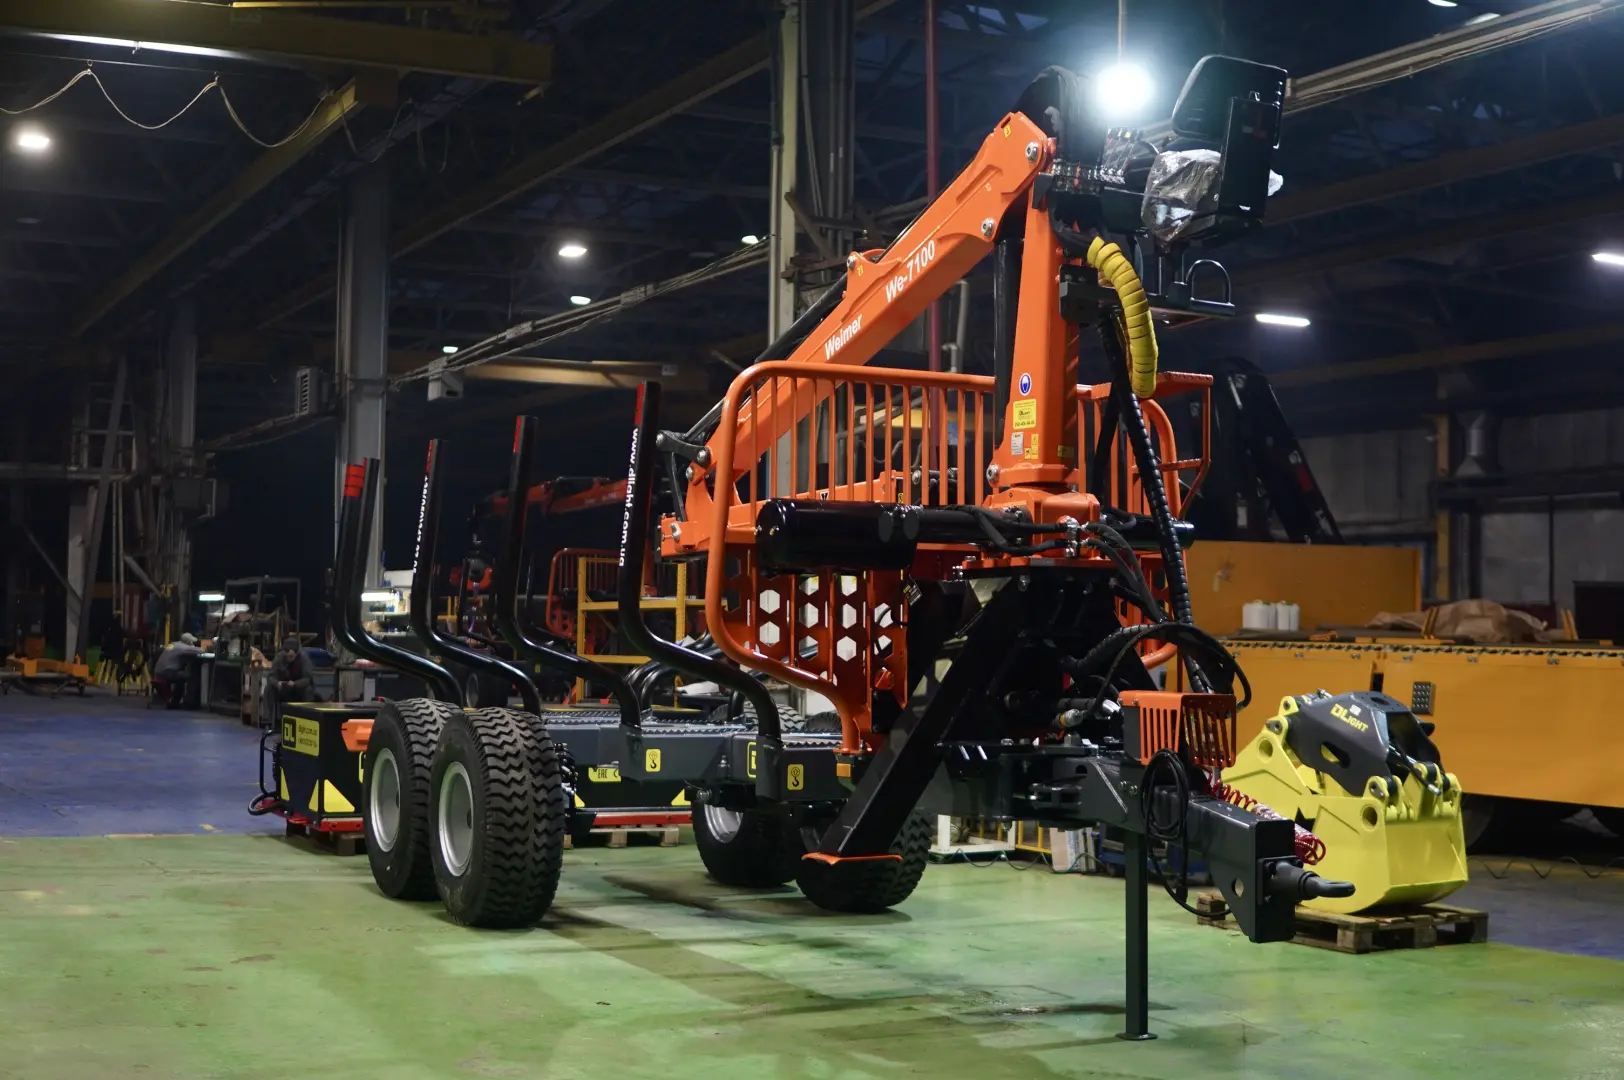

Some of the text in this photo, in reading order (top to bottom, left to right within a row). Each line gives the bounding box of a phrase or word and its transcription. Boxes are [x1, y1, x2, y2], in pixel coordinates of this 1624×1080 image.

[885, 239, 936, 303] We-7100
[824, 314, 863, 361] Weimer
[1330, 703, 1369, 732] DLIGHT
